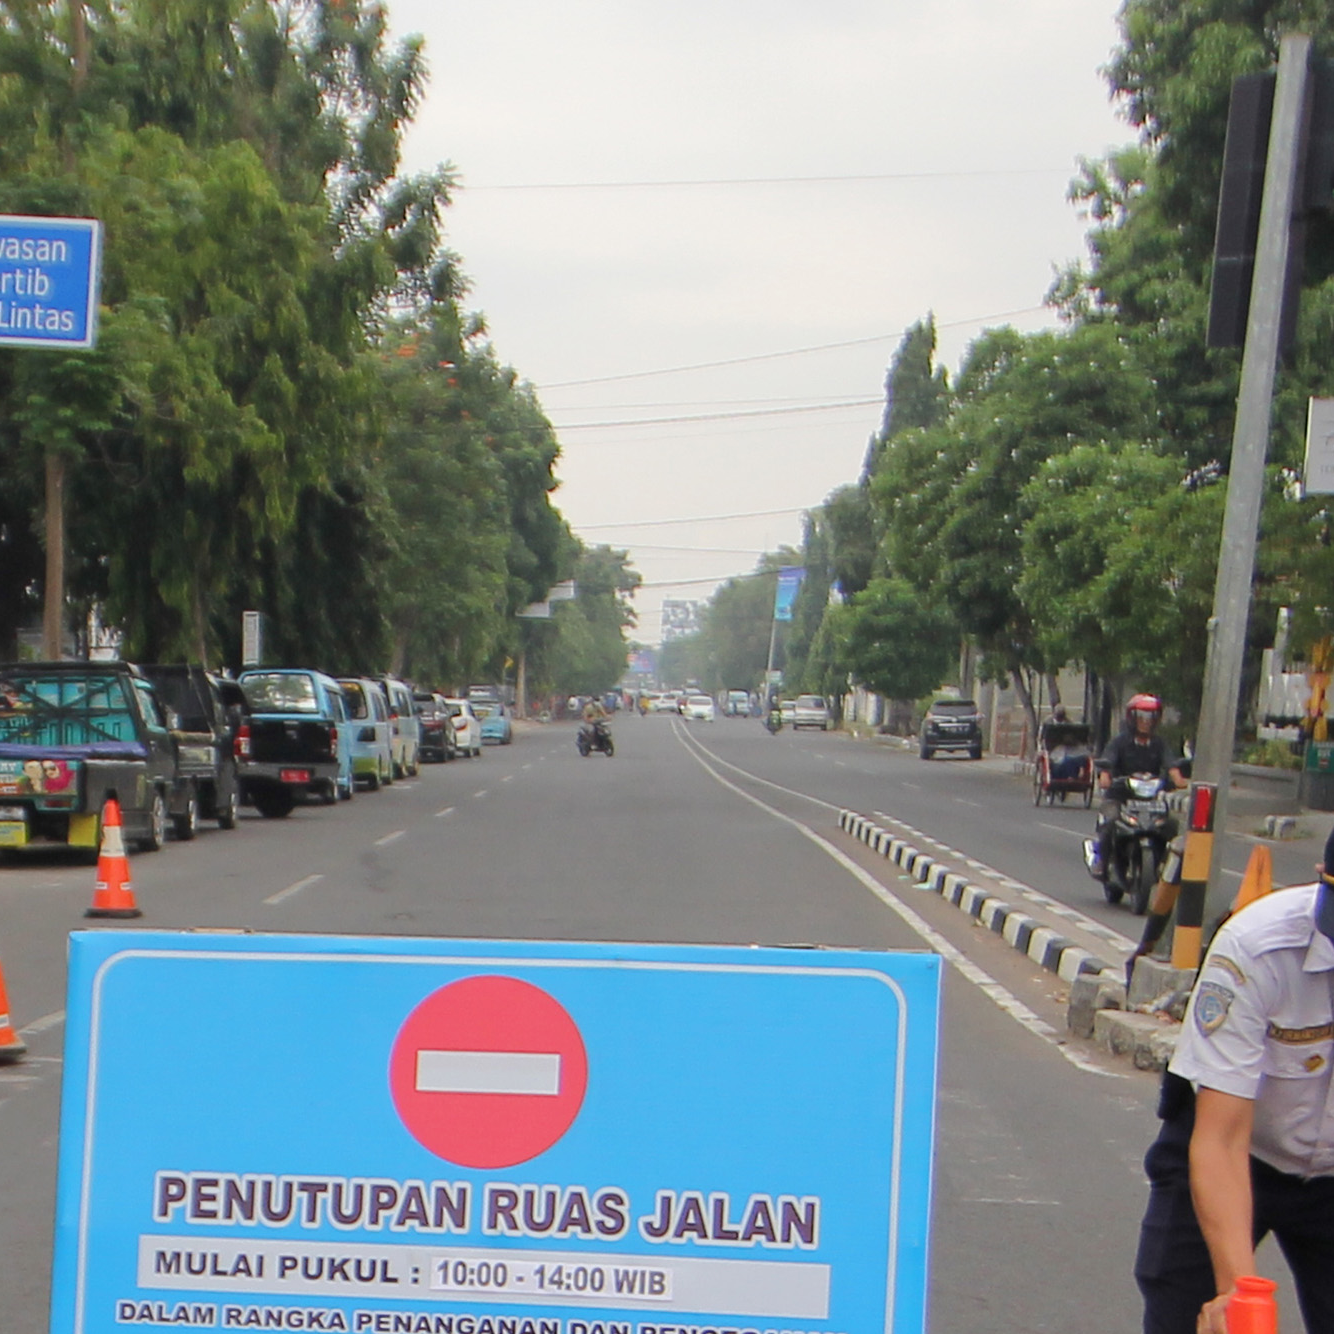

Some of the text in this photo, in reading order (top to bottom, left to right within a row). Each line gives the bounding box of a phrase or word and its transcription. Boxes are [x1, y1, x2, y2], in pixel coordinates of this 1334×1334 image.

[155, 1175, 817, 1245] PENUTUPAN RUAS JALAN
[154, 1250, 264, 1278] MULAI
[277, 1255, 399, 1284] PUKUL
[436, 1260, 508, 1288] 10:00
[533, 1264, 605, 1292] 14:00
[613, 1268, 667, 1295] WIB
[118, 1302, 215, 1325] DALAM
[224, 1307, 346, 1331] RANGKA
